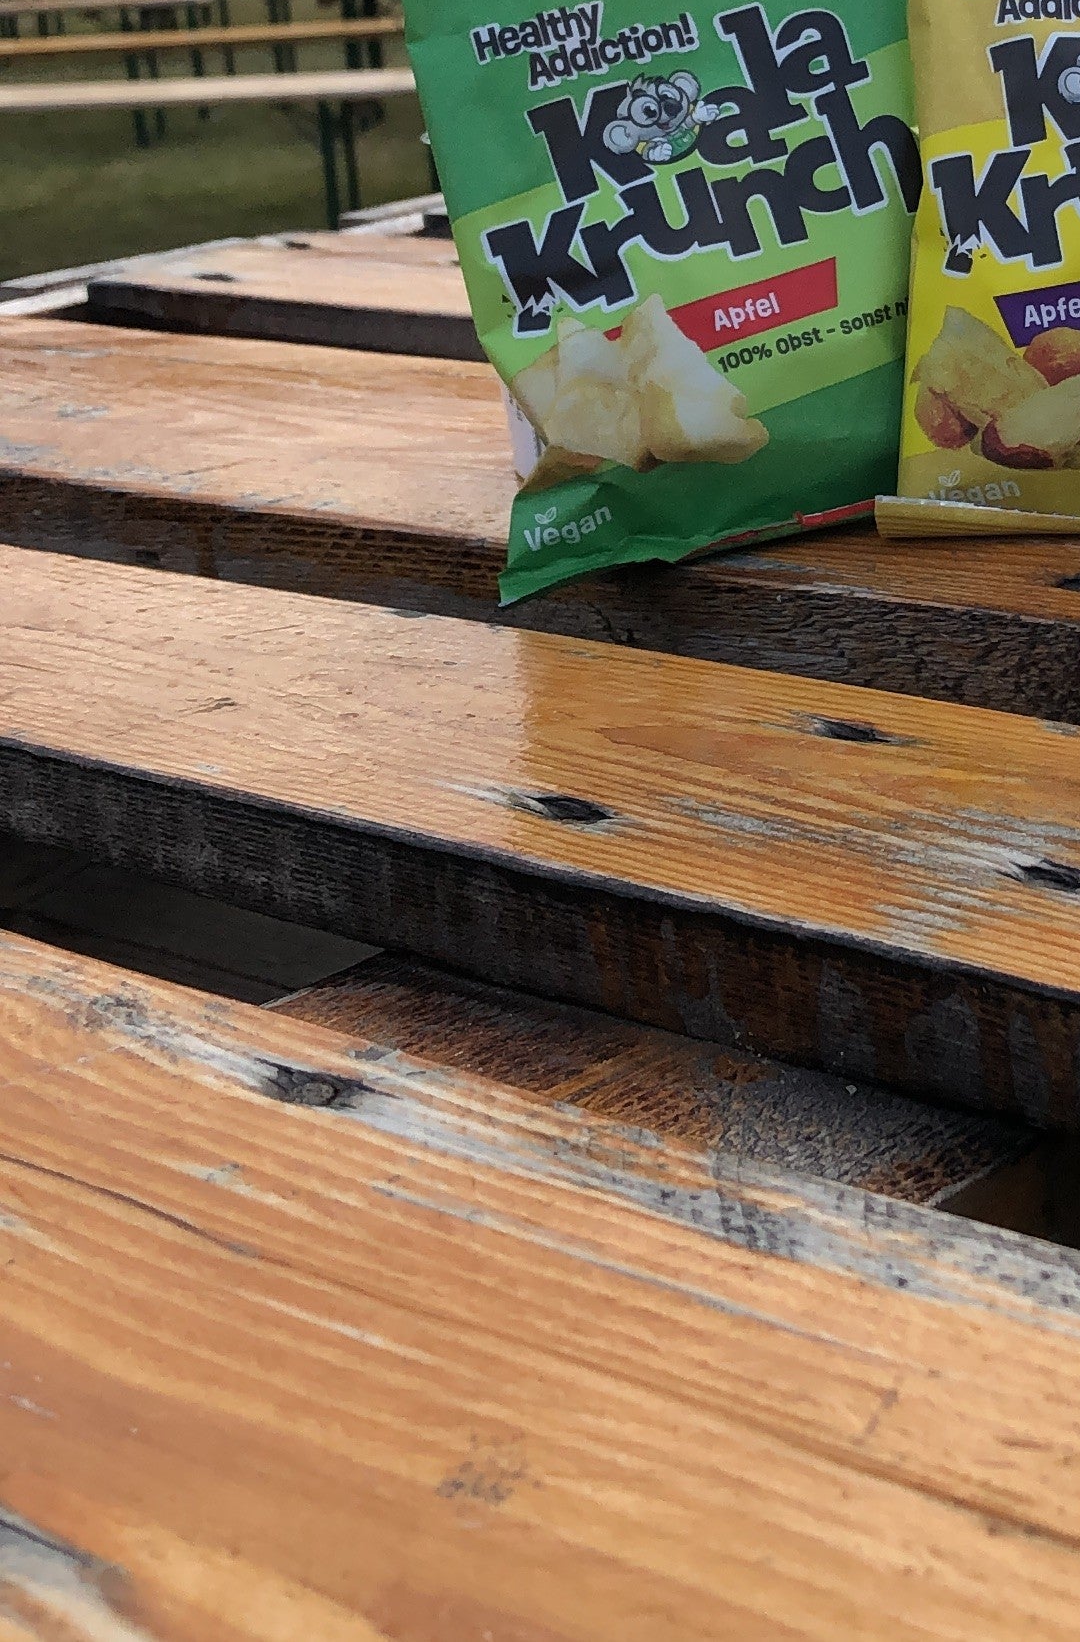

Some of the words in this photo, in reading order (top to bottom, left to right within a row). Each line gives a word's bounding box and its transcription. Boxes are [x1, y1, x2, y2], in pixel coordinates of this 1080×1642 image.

[471, 1, 604, 64] Healthy
[527, 12, 699, 91] Addiction!
[524, 2, 871, 206] Kala
[481, 84, 923, 338] Krunch
[713, 292, 781, 332] Apfel
[718, 342, 772, 373] 100%
[775, 327, 824, 356] Obst
[839, 304, 893, 335] sonst
[523, 502, 613, 553] Vegan
